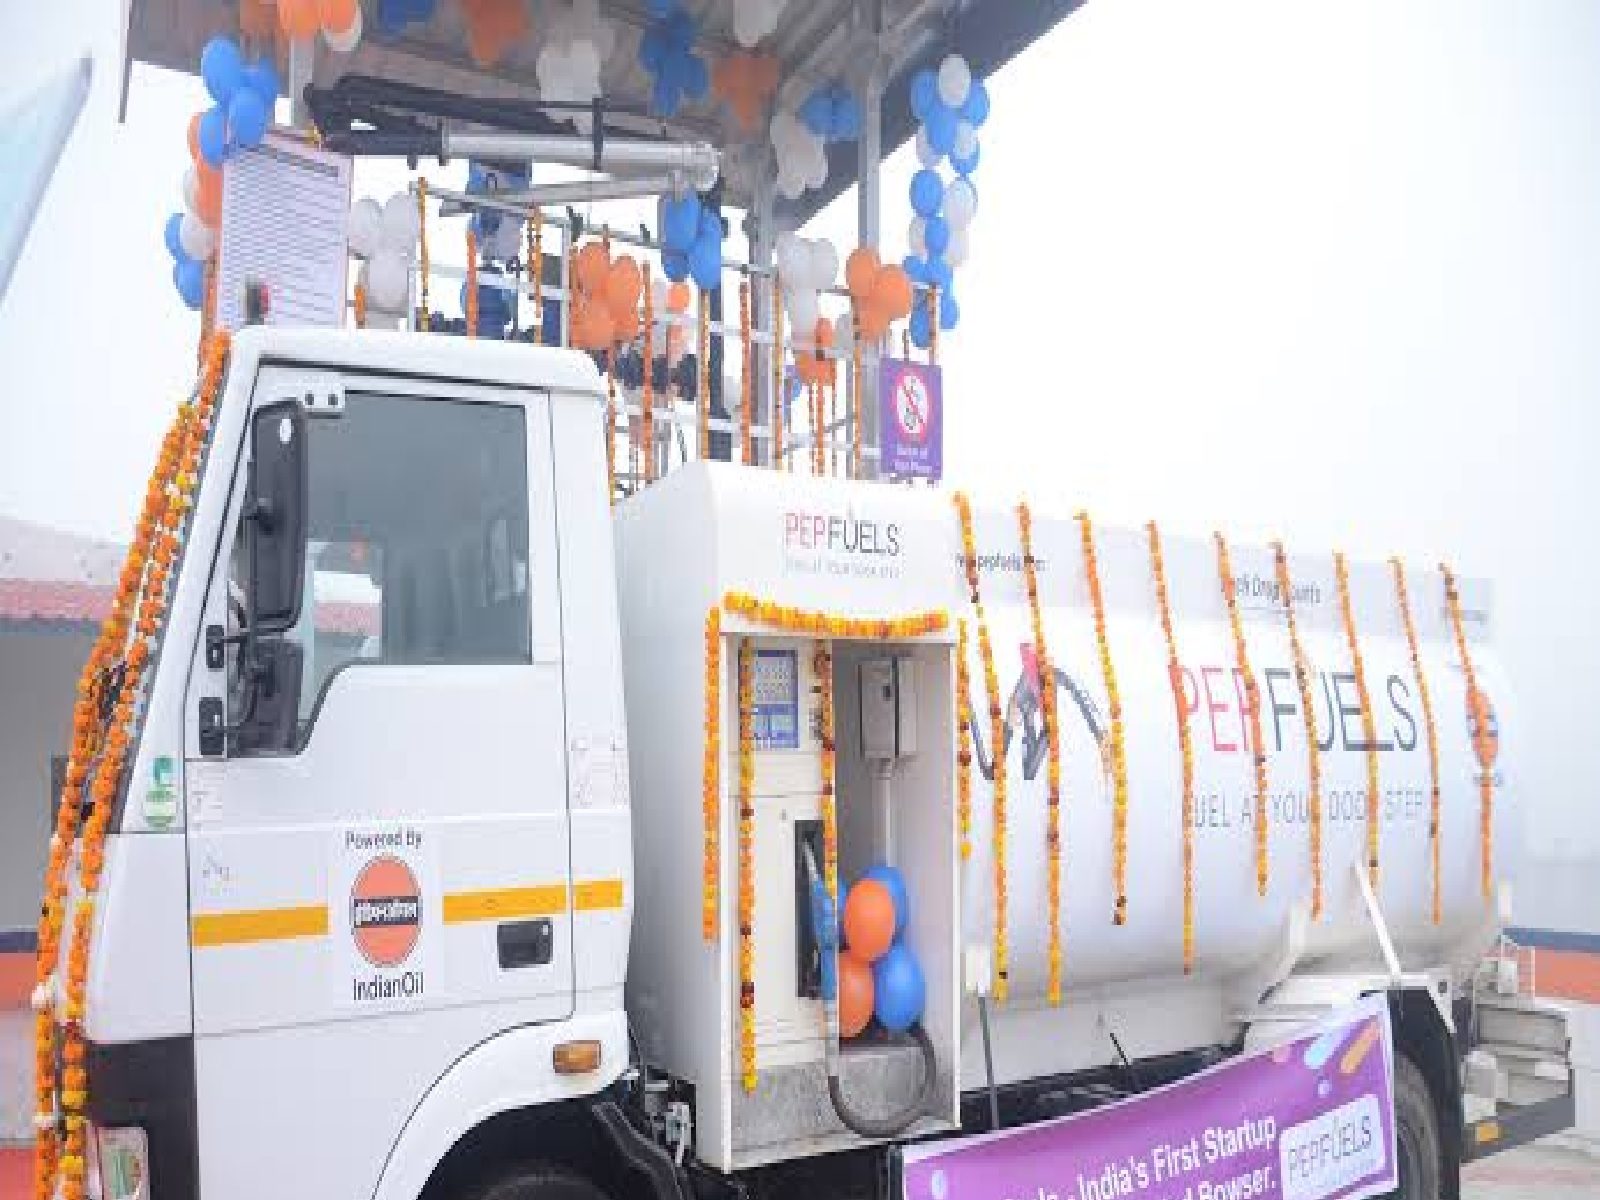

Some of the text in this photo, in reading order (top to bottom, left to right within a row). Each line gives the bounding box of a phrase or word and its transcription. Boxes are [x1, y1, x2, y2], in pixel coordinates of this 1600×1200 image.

[785, 511, 900, 556] PEPFUELS
[1186, 793, 1231, 828] UEL
[1271, 793, 1314, 824] YOU
[1328, 789, 1372, 822] DOO
[345, 827, 403, 849] Powered
[353, 971, 425, 1000] IndianOil
[1077, 1115, 1276, 1200] India's First Startup
[1288, 1115, 1371, 1186] PEPFUELS
